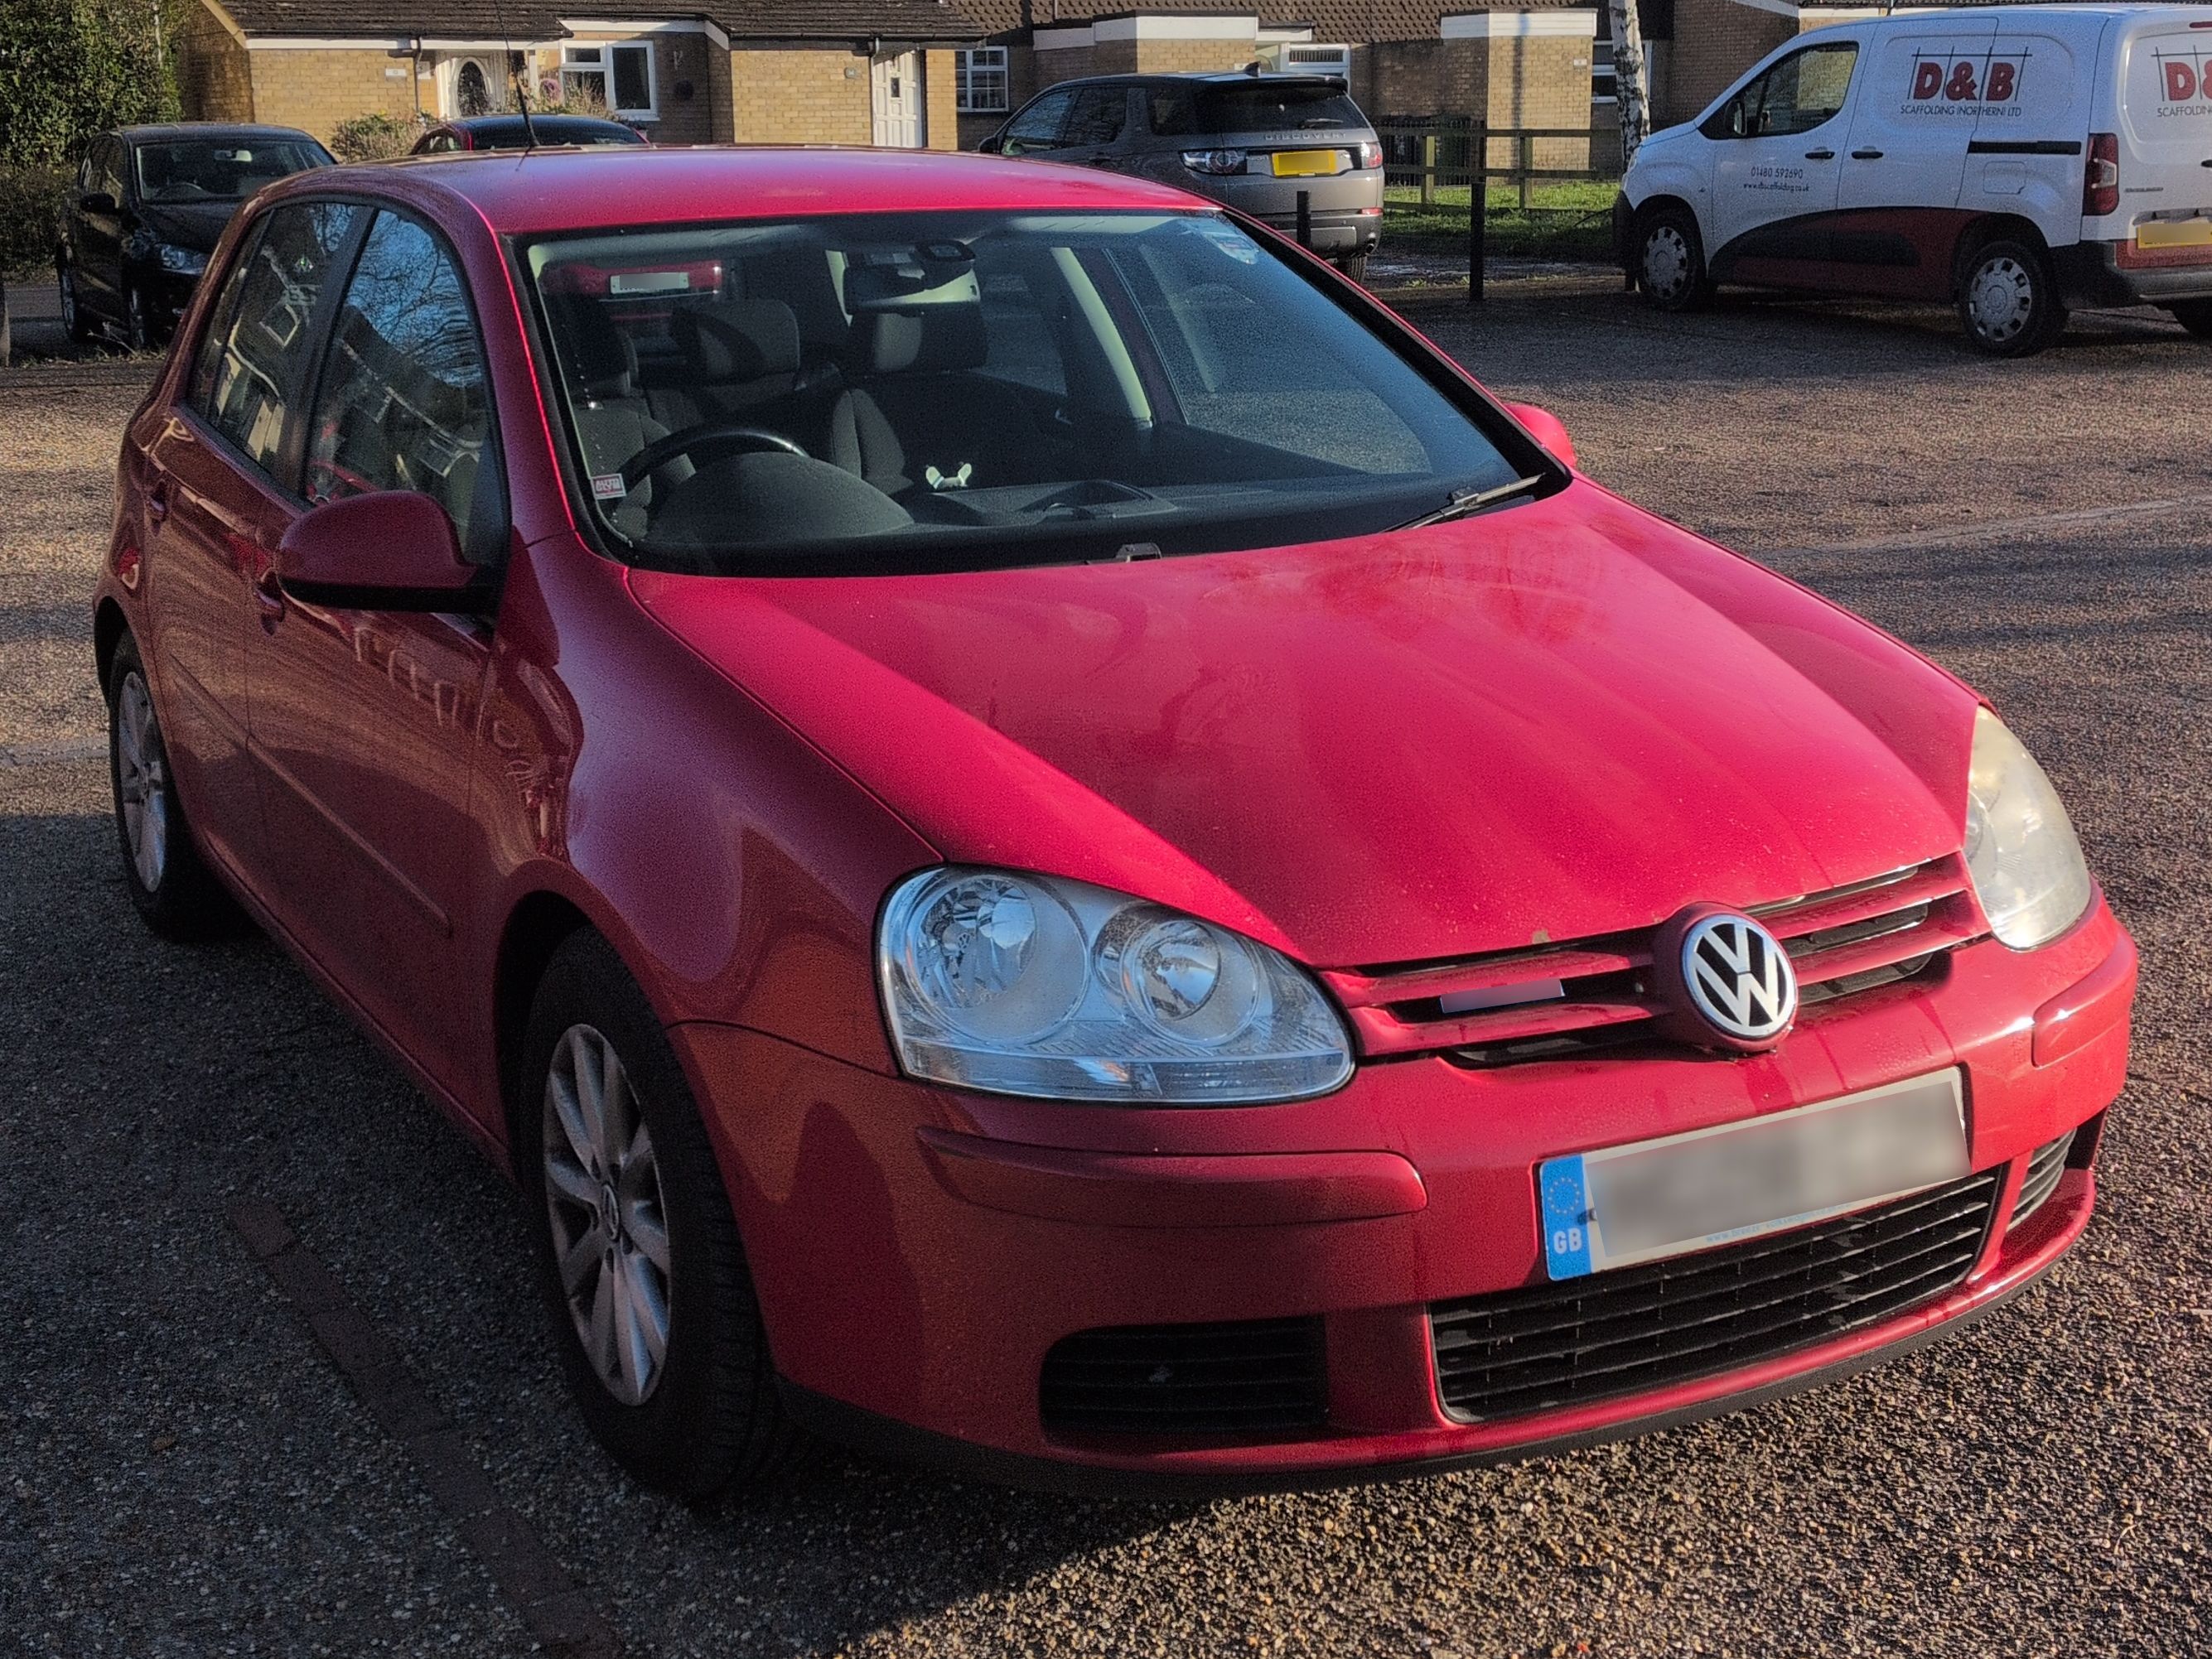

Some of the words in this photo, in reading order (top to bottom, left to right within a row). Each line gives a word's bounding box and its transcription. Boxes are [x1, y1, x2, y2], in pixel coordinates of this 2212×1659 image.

[1913, 61, 2015, 101] D&B
[1900, 104, 1955, 115] SCAFFOLDING
[2007, 107, 2021, 117] LTD
[1264, 132, 1346, 141] DISCOVERY
[1686, 917, 1793, 1032] VW
[1553, 1227, 1582, 1254] GB
